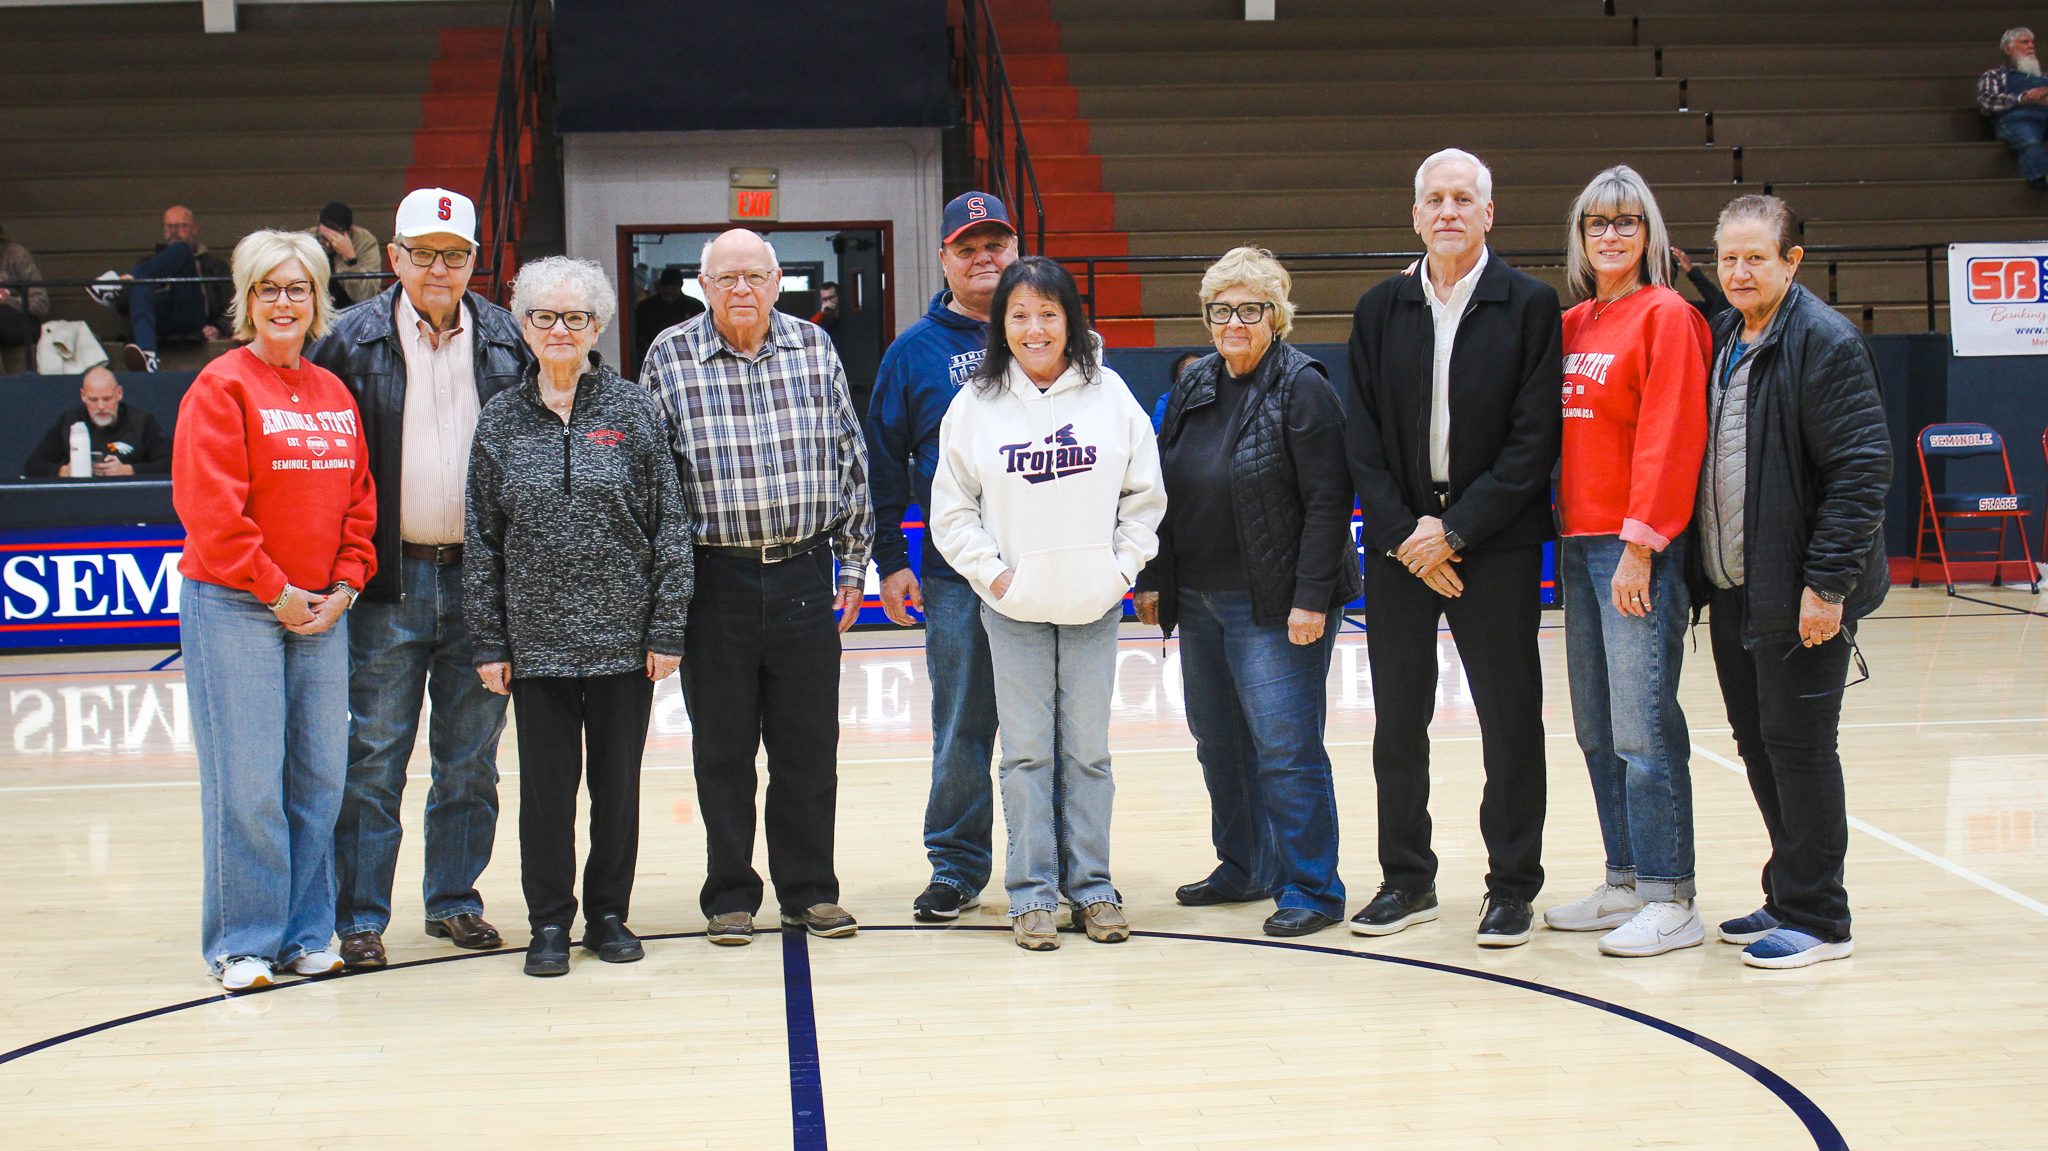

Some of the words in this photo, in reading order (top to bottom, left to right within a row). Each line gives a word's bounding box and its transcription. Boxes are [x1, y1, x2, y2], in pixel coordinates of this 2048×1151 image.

[438, 196, 452, 221] S
[737, 191, 773, 217] EXIT
[967, 197, 987, 219] S
[1970, 261, 2037, 300] SB
[1930, 433, 1993, 447] SEMINOLE
[272, 459, 310, 471] SEMINOLE,
[312, 459, 348, 470] OKLAHOMA
[999, 441, 1097, 474] Trojans
[1978, 497, 2018, 511] STATE
